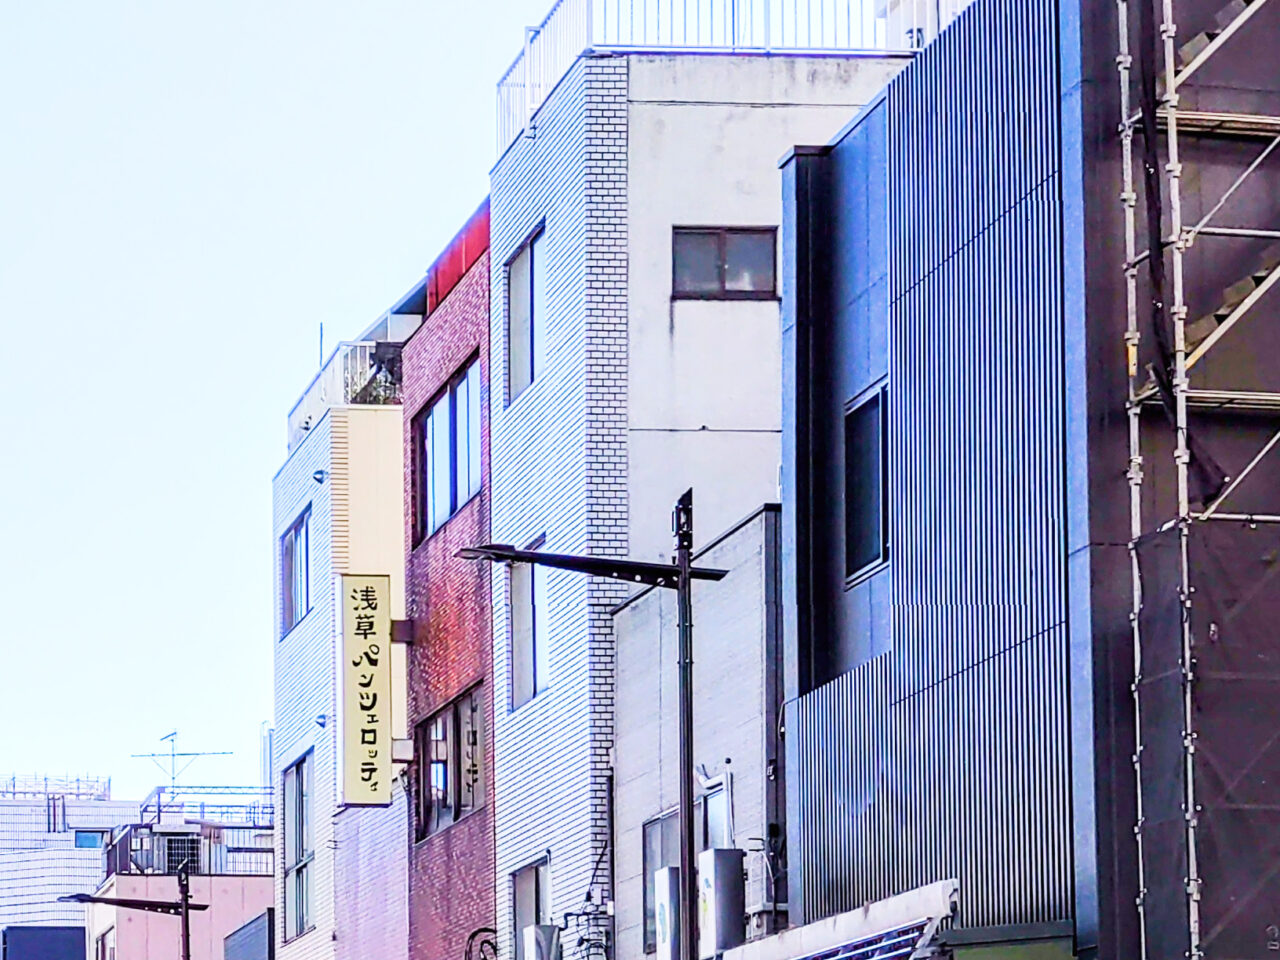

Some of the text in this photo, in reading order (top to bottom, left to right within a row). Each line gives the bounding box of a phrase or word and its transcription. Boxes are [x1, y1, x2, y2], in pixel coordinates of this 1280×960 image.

[350, 586, 380, 792] 浅草パンツェロッティ
